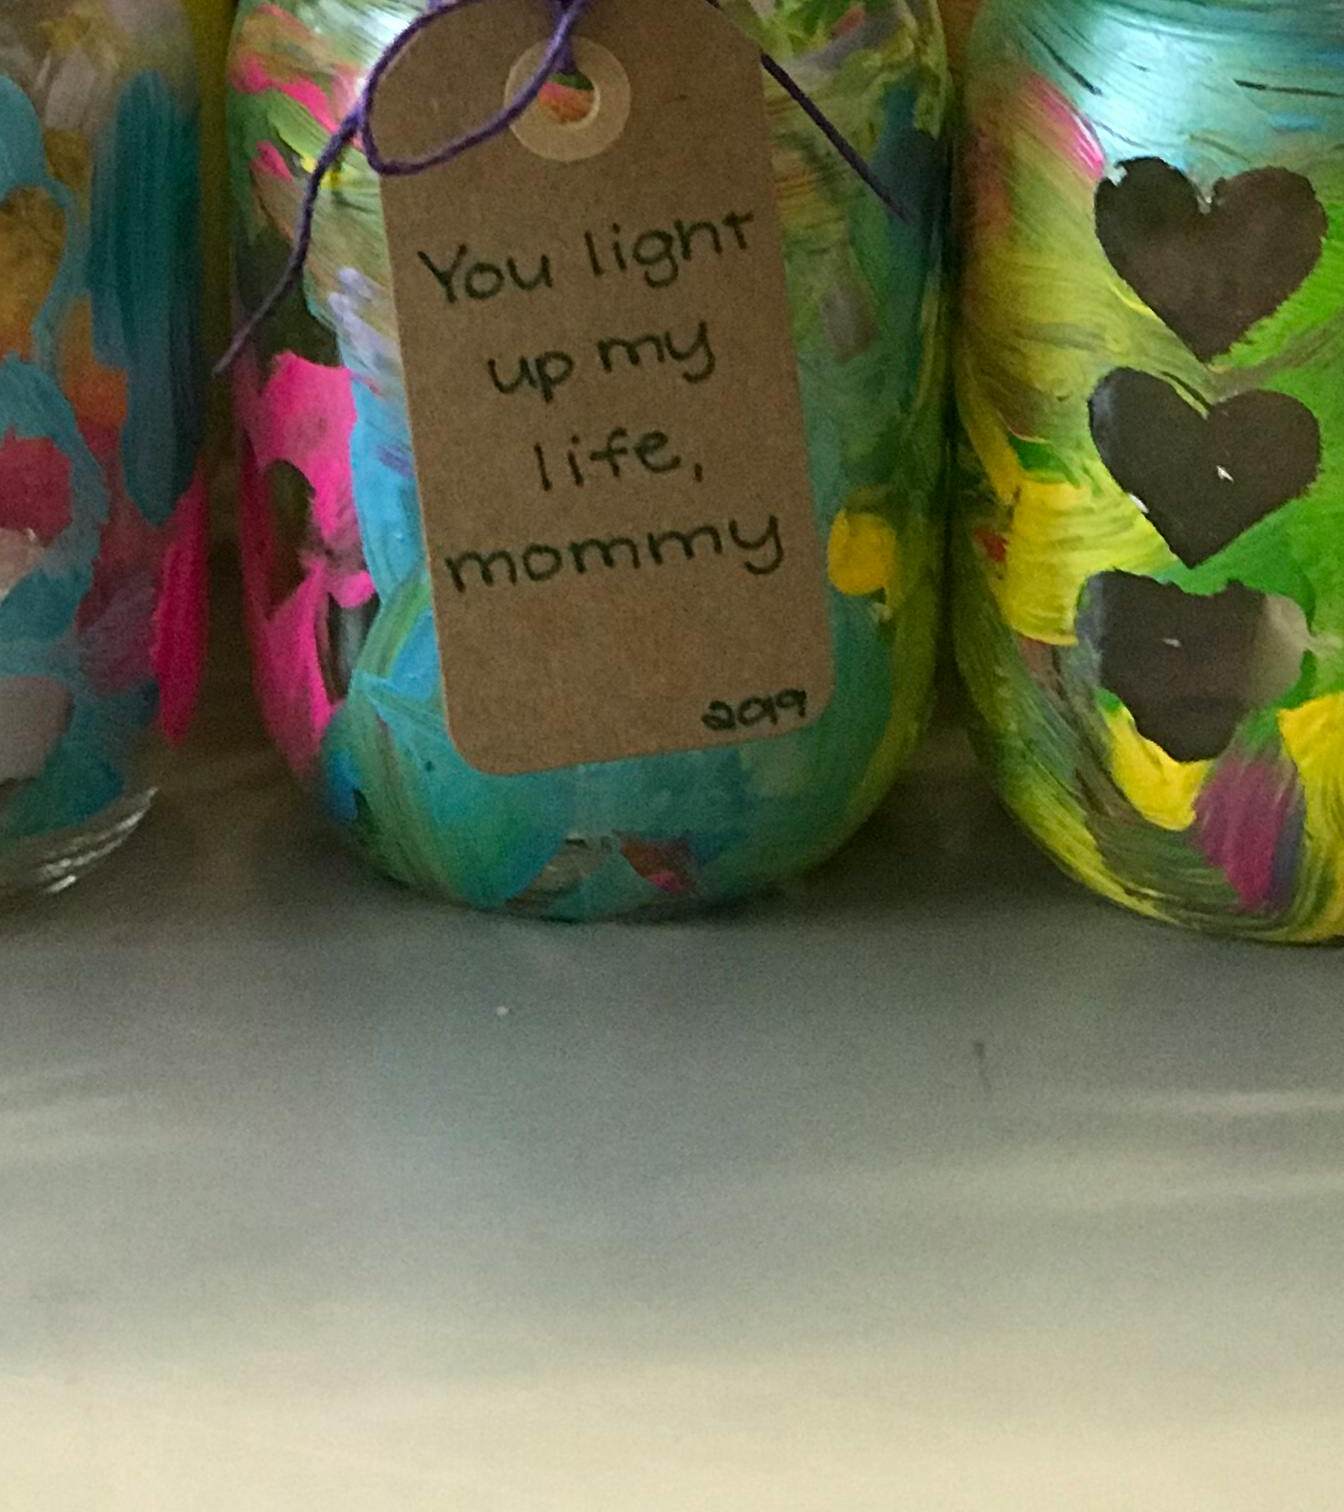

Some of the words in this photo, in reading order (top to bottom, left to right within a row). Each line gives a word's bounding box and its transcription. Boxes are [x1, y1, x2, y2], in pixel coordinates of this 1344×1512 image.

[417, 244, 553, 304] You
[584, 211, 753, 288] light
[487, 350, 575, 404] up
[597, 320, 716, 384] my
[533, 427, 704, 492] life,
[444, 515, 784, 593] mommy
[701, 688, 807, 731] 2019
